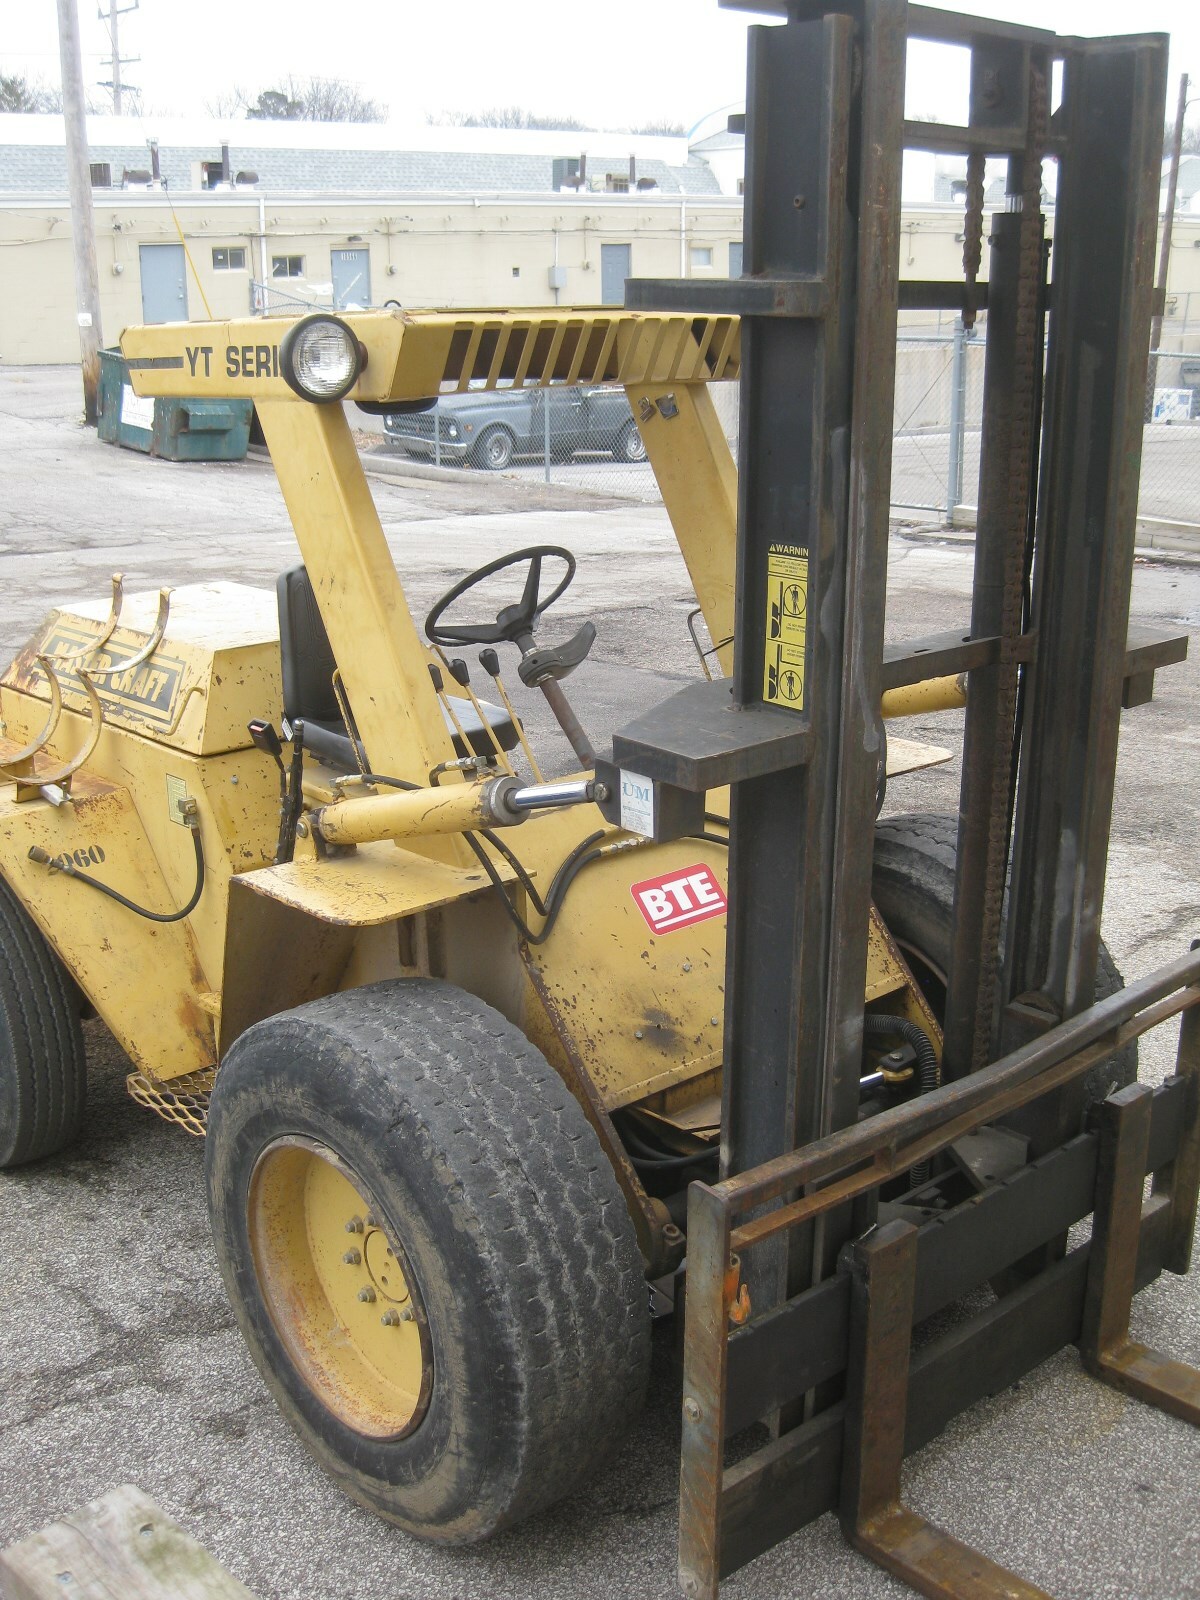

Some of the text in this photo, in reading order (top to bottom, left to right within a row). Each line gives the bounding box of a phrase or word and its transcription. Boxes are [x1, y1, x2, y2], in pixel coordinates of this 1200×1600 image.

[185, 345, 283, 378] YT SERI
[775, 544, 809, 557] WARNIN
[622, 782, 650, 802] UM
[48, 844, 105, 876] 060
[638, 871, 720, 922] BTE
